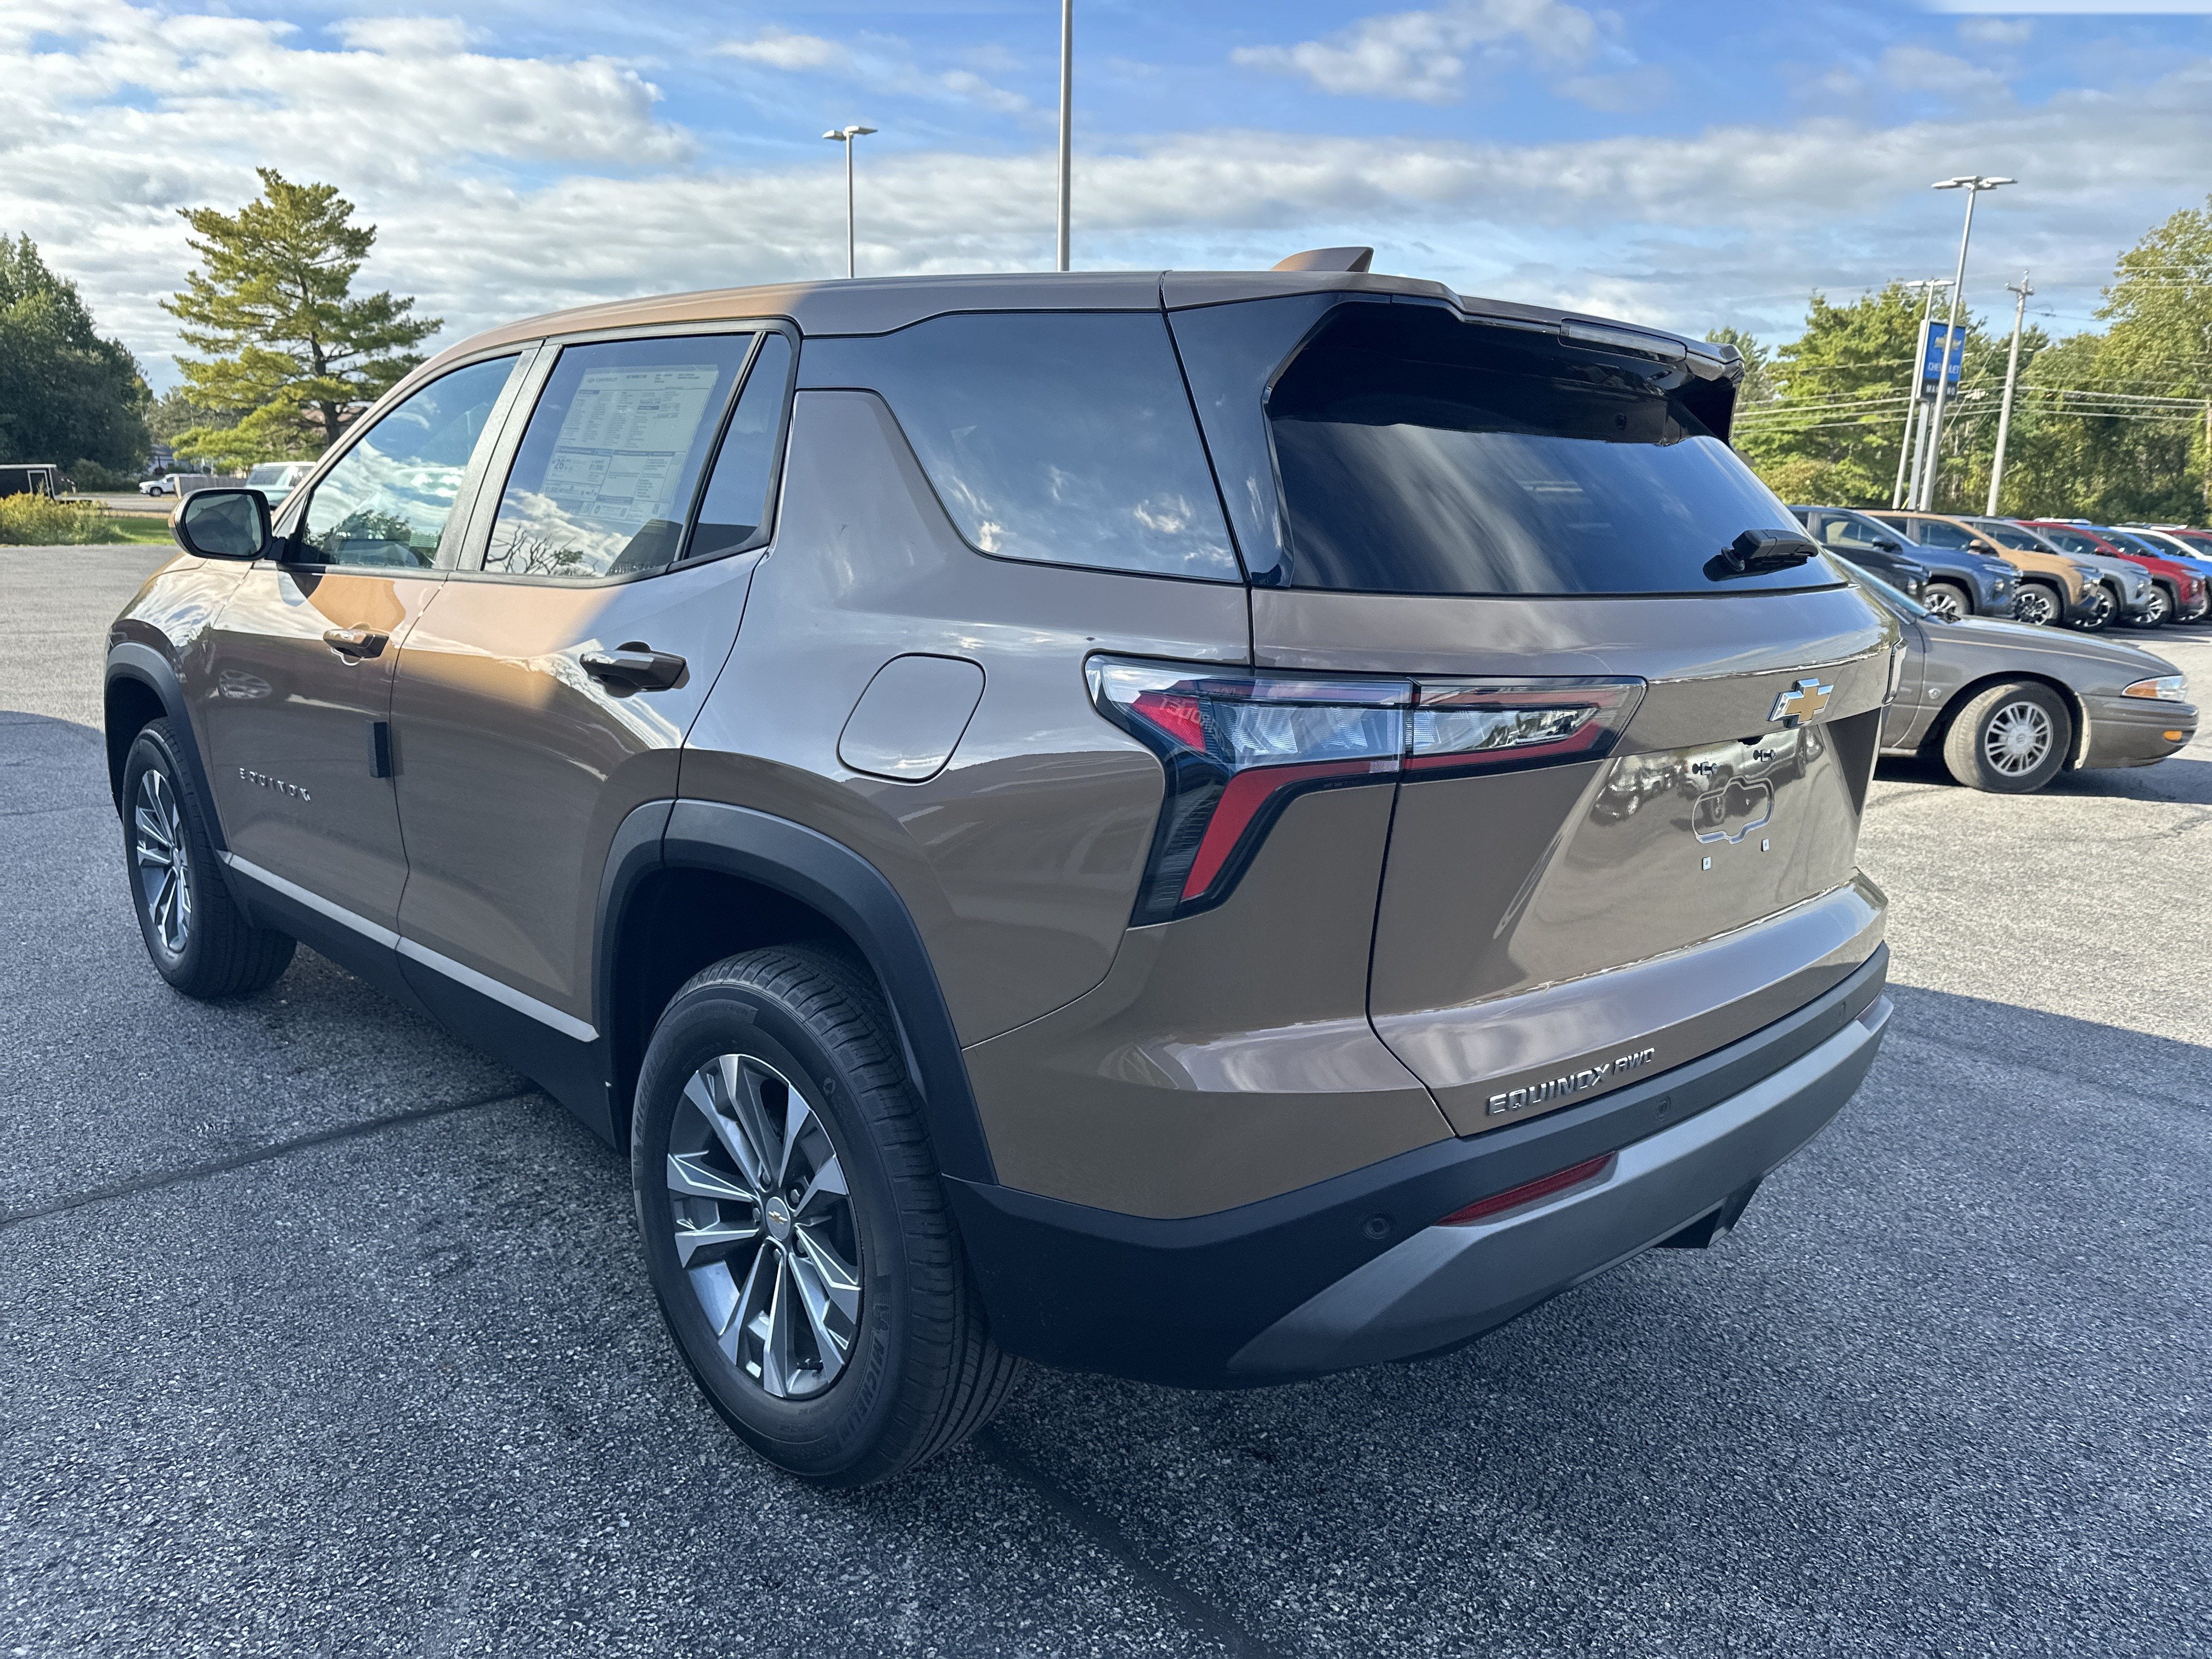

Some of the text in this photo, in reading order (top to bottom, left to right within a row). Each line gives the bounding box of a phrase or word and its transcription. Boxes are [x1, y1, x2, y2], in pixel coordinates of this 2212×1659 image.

[1928, 362, 1960, 374] CHELET
[1487, 1047, 1655, 1115] EQUINOX AWD
